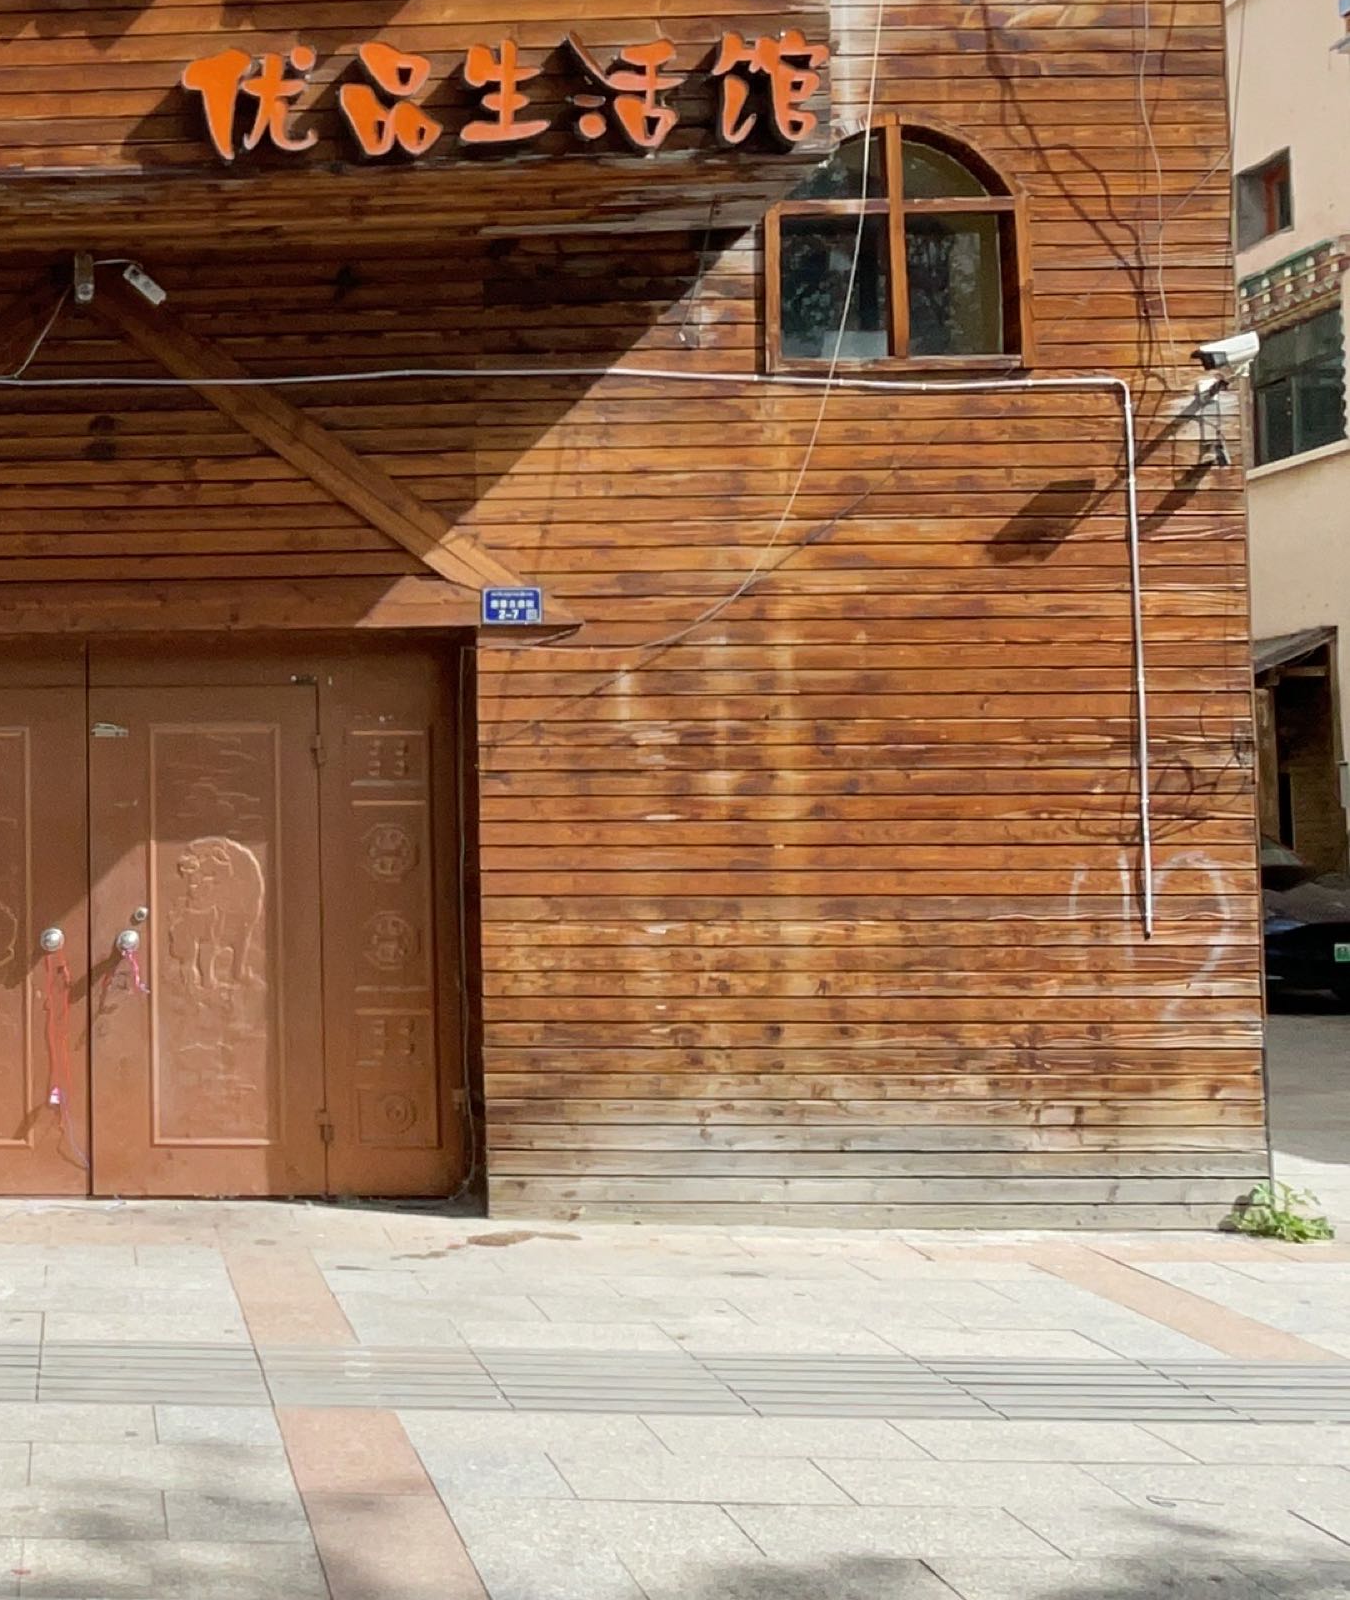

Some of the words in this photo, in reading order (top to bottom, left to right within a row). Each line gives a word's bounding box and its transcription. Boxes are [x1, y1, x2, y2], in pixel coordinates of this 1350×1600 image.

[182, 28, 832, 160] 优品生活馆
